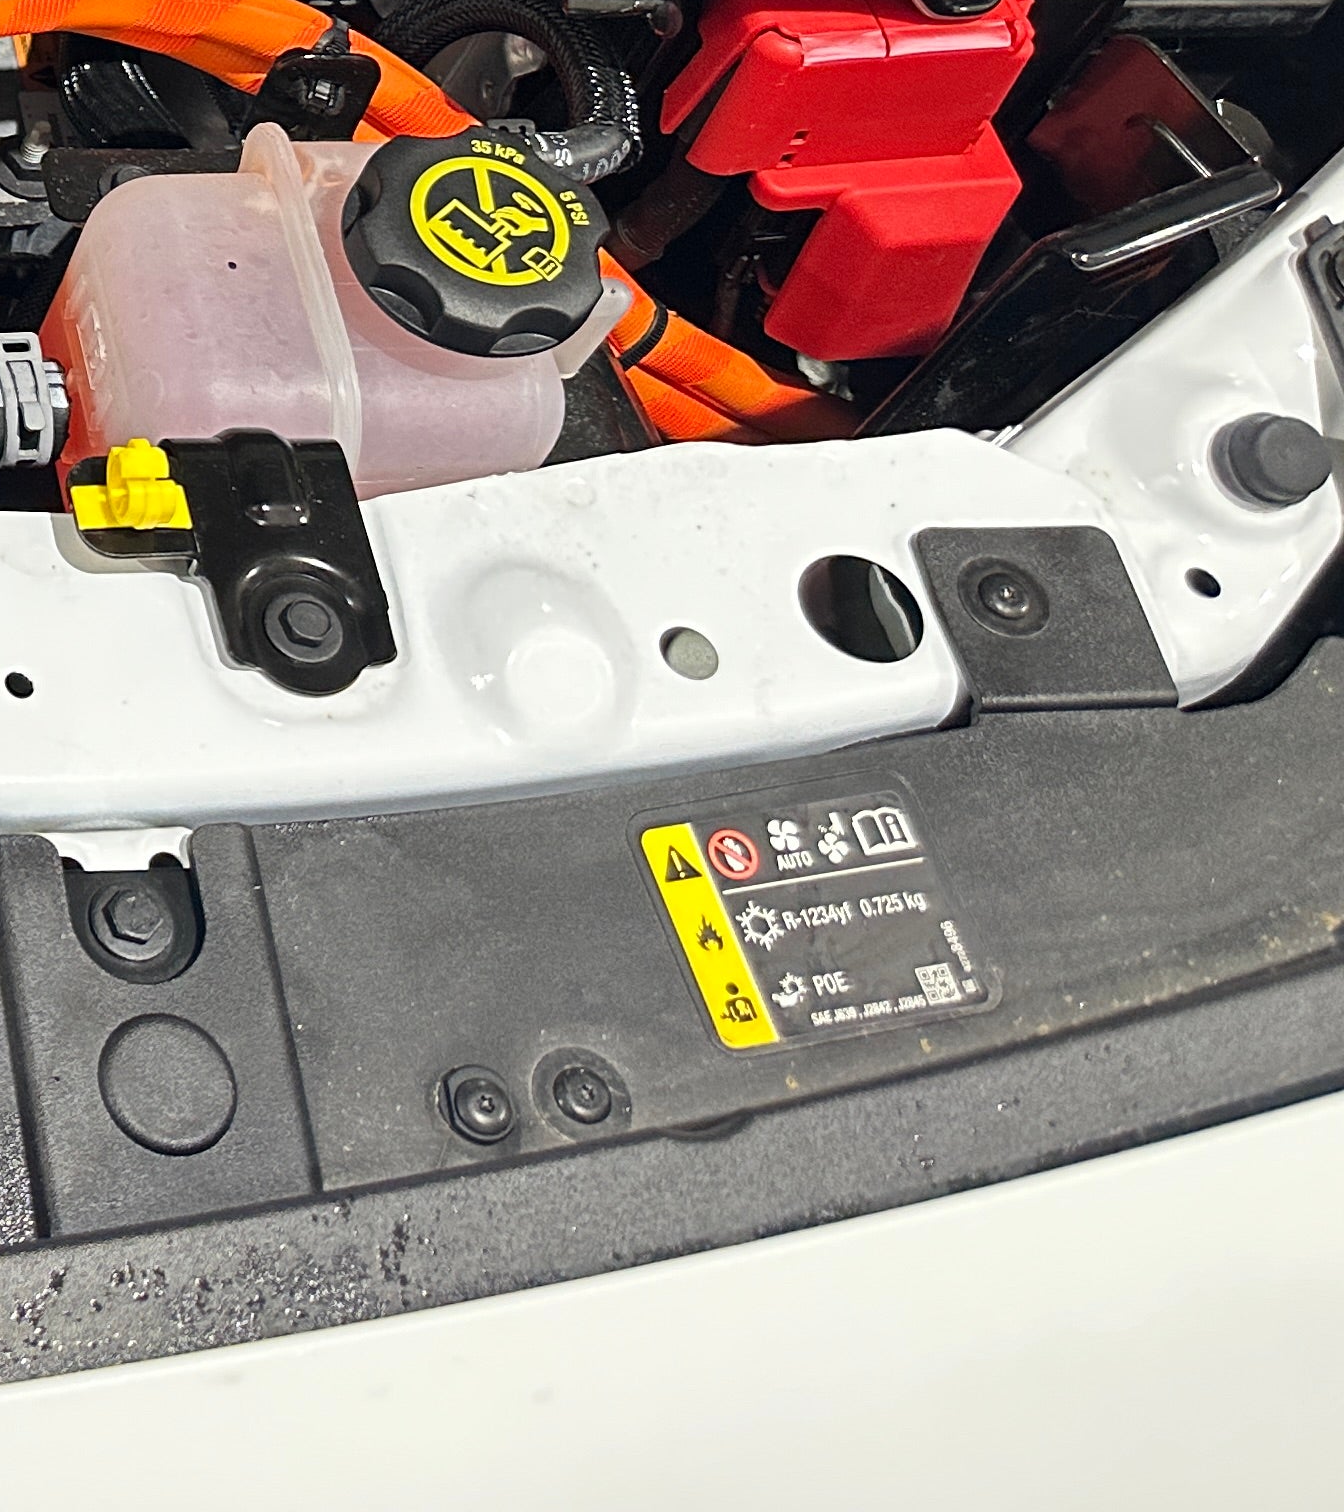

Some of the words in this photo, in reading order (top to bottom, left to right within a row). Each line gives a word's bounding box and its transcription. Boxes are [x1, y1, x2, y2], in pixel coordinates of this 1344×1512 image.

[470, 139, 492, 154] 35
[493, 143, 526, 165] kPa
[559, 190, 576, 201] 5
[565, 202, 590, 225] PSI
[776, 849, 813, 872] AUTO
[781, 899, 853, 934] R-1234yf
[859, 891, 904, 919] 0.725
[902, 888, 927, 915] kg
[812, 968, 850, 998] POE
[810, 1009, 829, 1027] SAE
